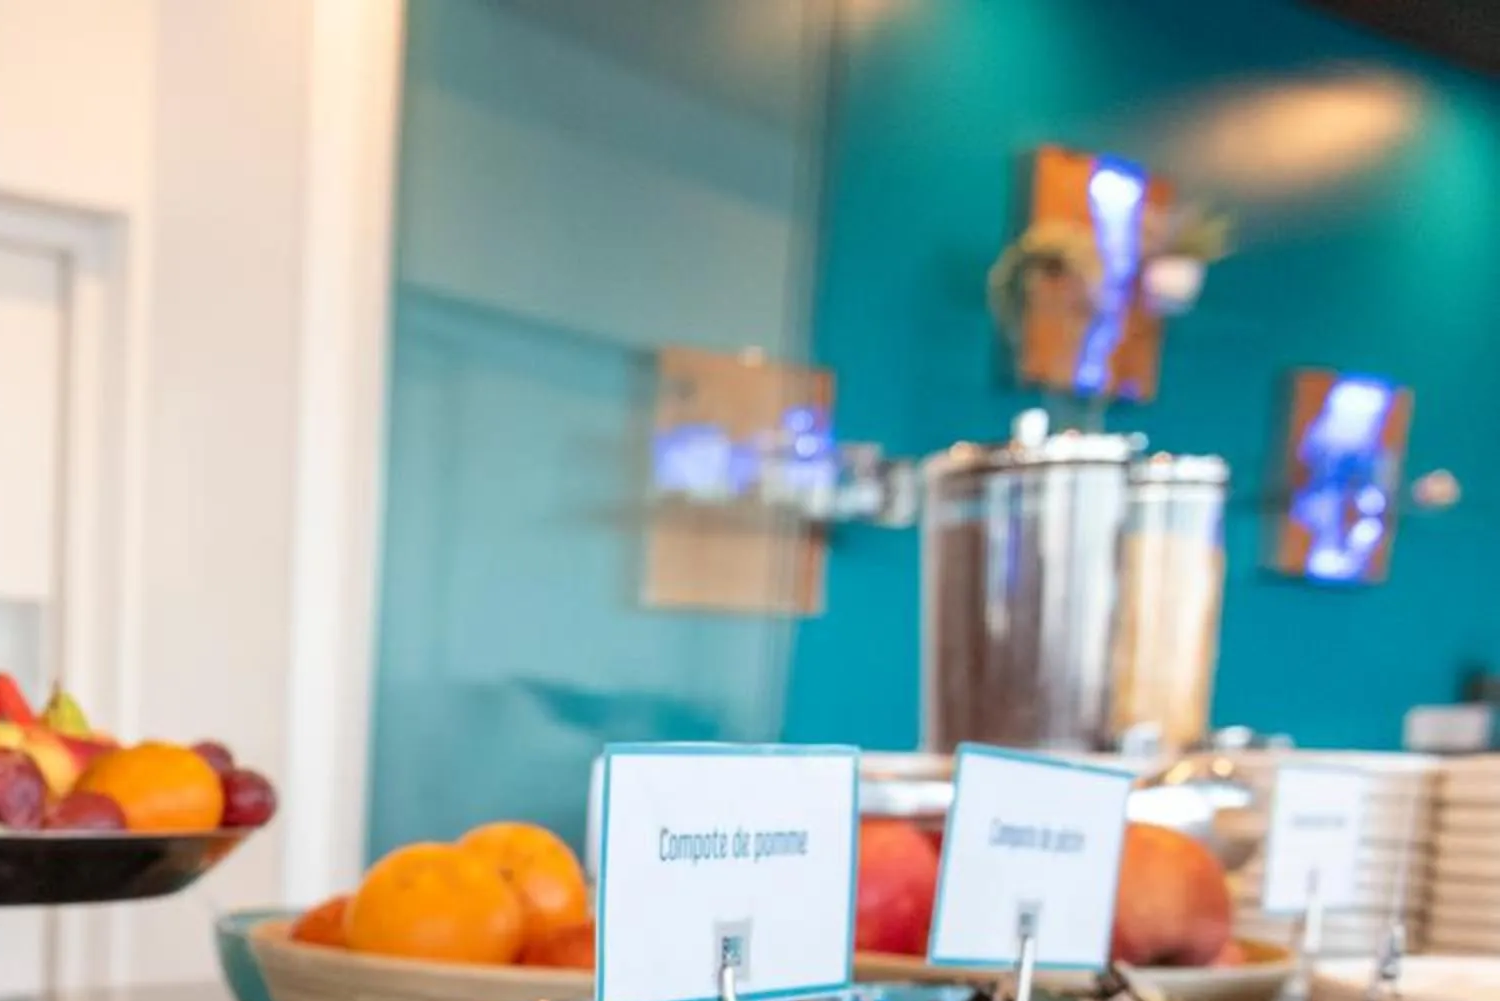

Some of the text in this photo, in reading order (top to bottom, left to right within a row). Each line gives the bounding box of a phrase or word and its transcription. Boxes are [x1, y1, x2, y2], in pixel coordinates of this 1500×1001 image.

[659, 826, 808, 866] Compote de pomme
